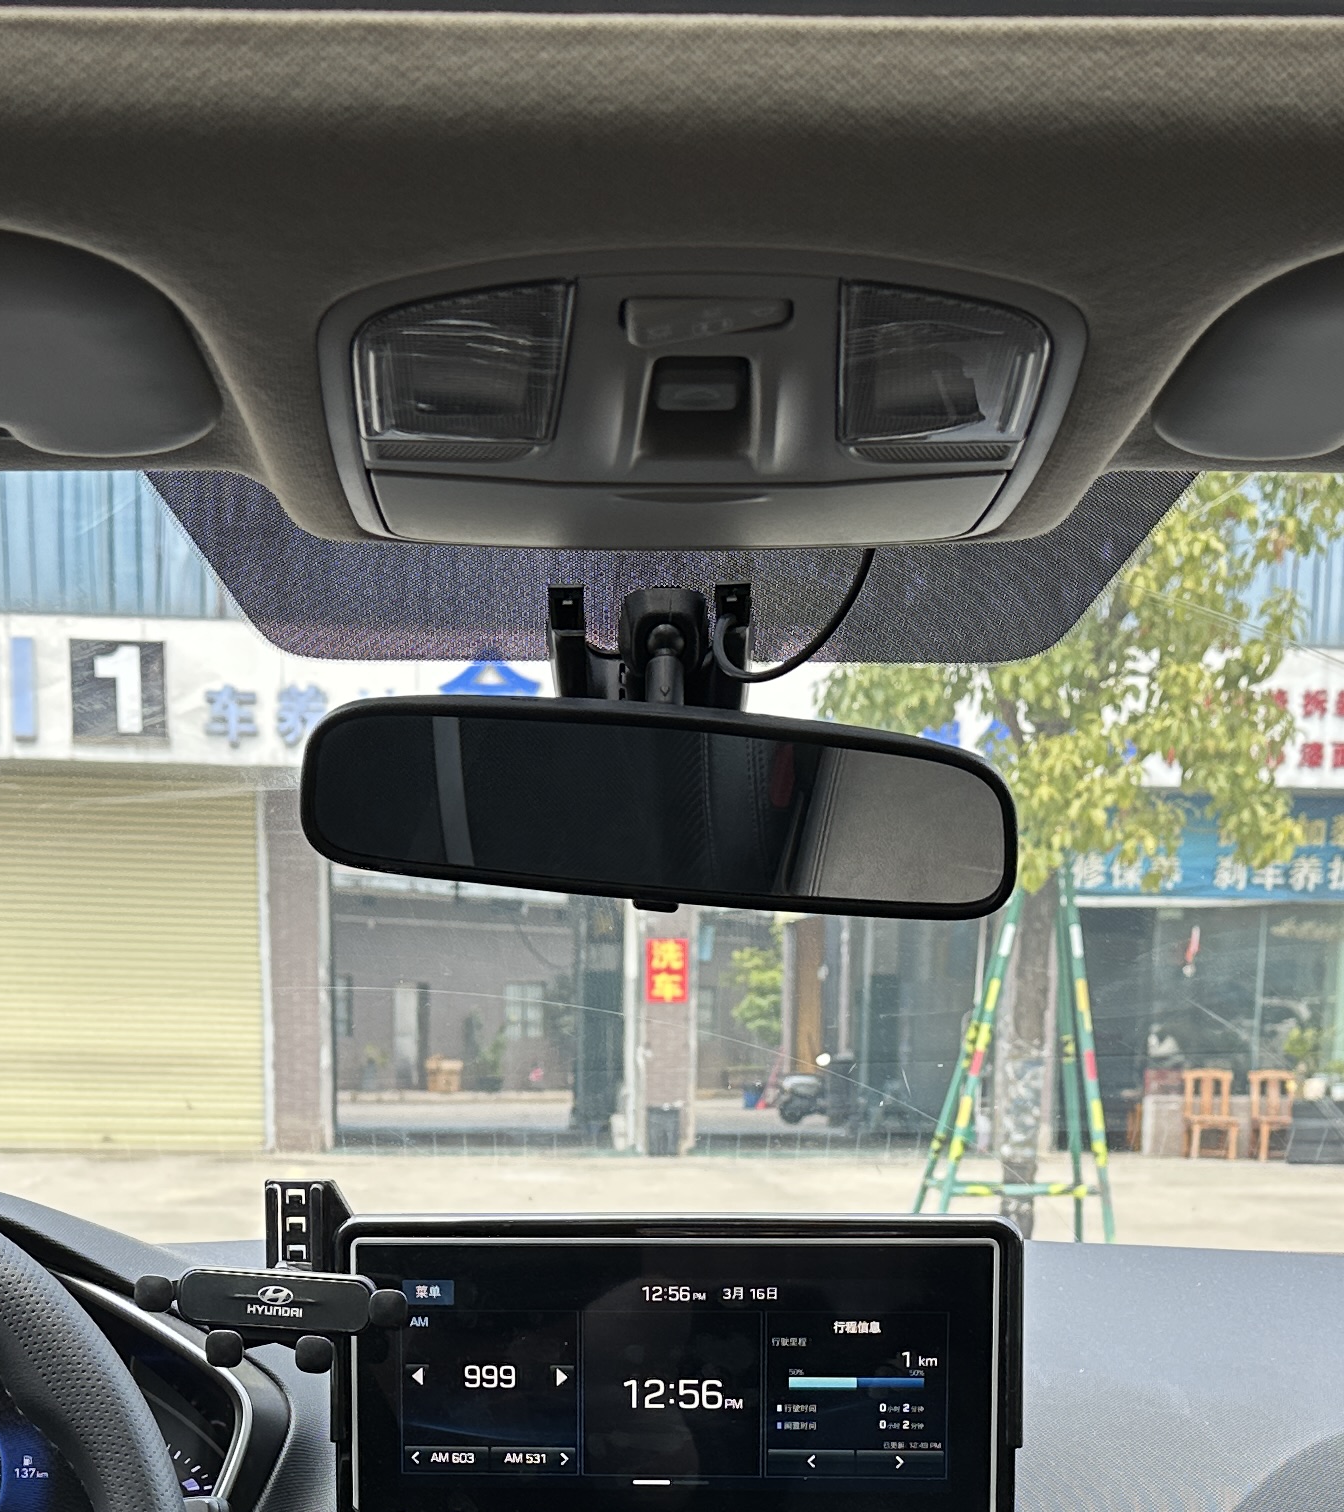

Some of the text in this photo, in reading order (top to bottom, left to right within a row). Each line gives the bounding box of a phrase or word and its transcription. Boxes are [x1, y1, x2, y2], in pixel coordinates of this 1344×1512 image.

[93, 644, 143, 735] 1
[650, 939, 685, 1003] 洗车
[415, 1285, 441, 1299] 菜单
[641, 1286, 706, 1302] 12:56 PM
[722, 1287, 778, 1300] 3月 16日
[246, 1304, 304, 1318] HYUNDAI
[409, 1317, 429, 1328] AM
[833, 1320, 882, 1334] 行程信息
[902, 1351, 938, 1368] 1 km
[464, 1365, 516, 1388] 999
[623, 1378, 744, 1410] 12:56 PM
[430, 1453, 475, 1464] AM 603
[504, 1453, 547, 1464] AM 531
